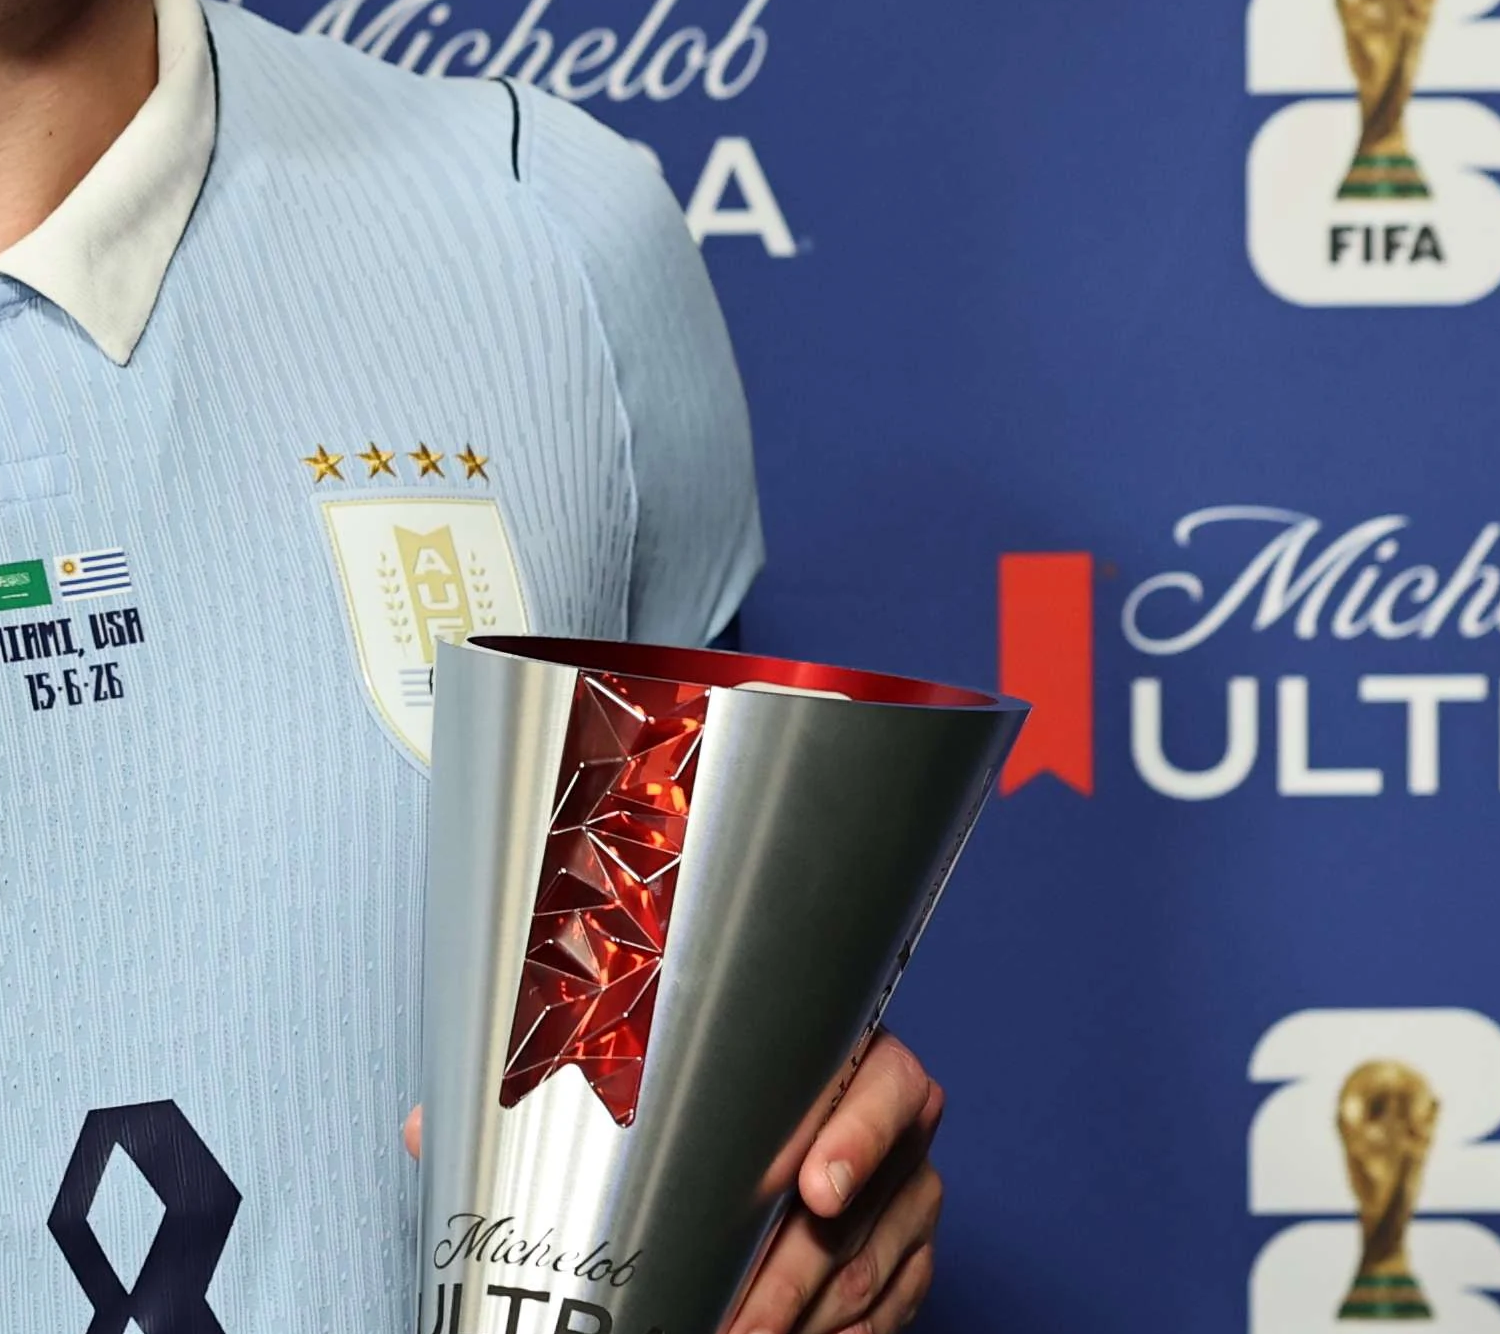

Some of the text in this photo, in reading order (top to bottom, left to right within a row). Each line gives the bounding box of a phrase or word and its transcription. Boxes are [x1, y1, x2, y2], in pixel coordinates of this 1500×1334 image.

[1330, 225, 1443, 263] FIFA
[88, 607, 145, 651] USA
[434, 1213, 642, 1287] Michelob
